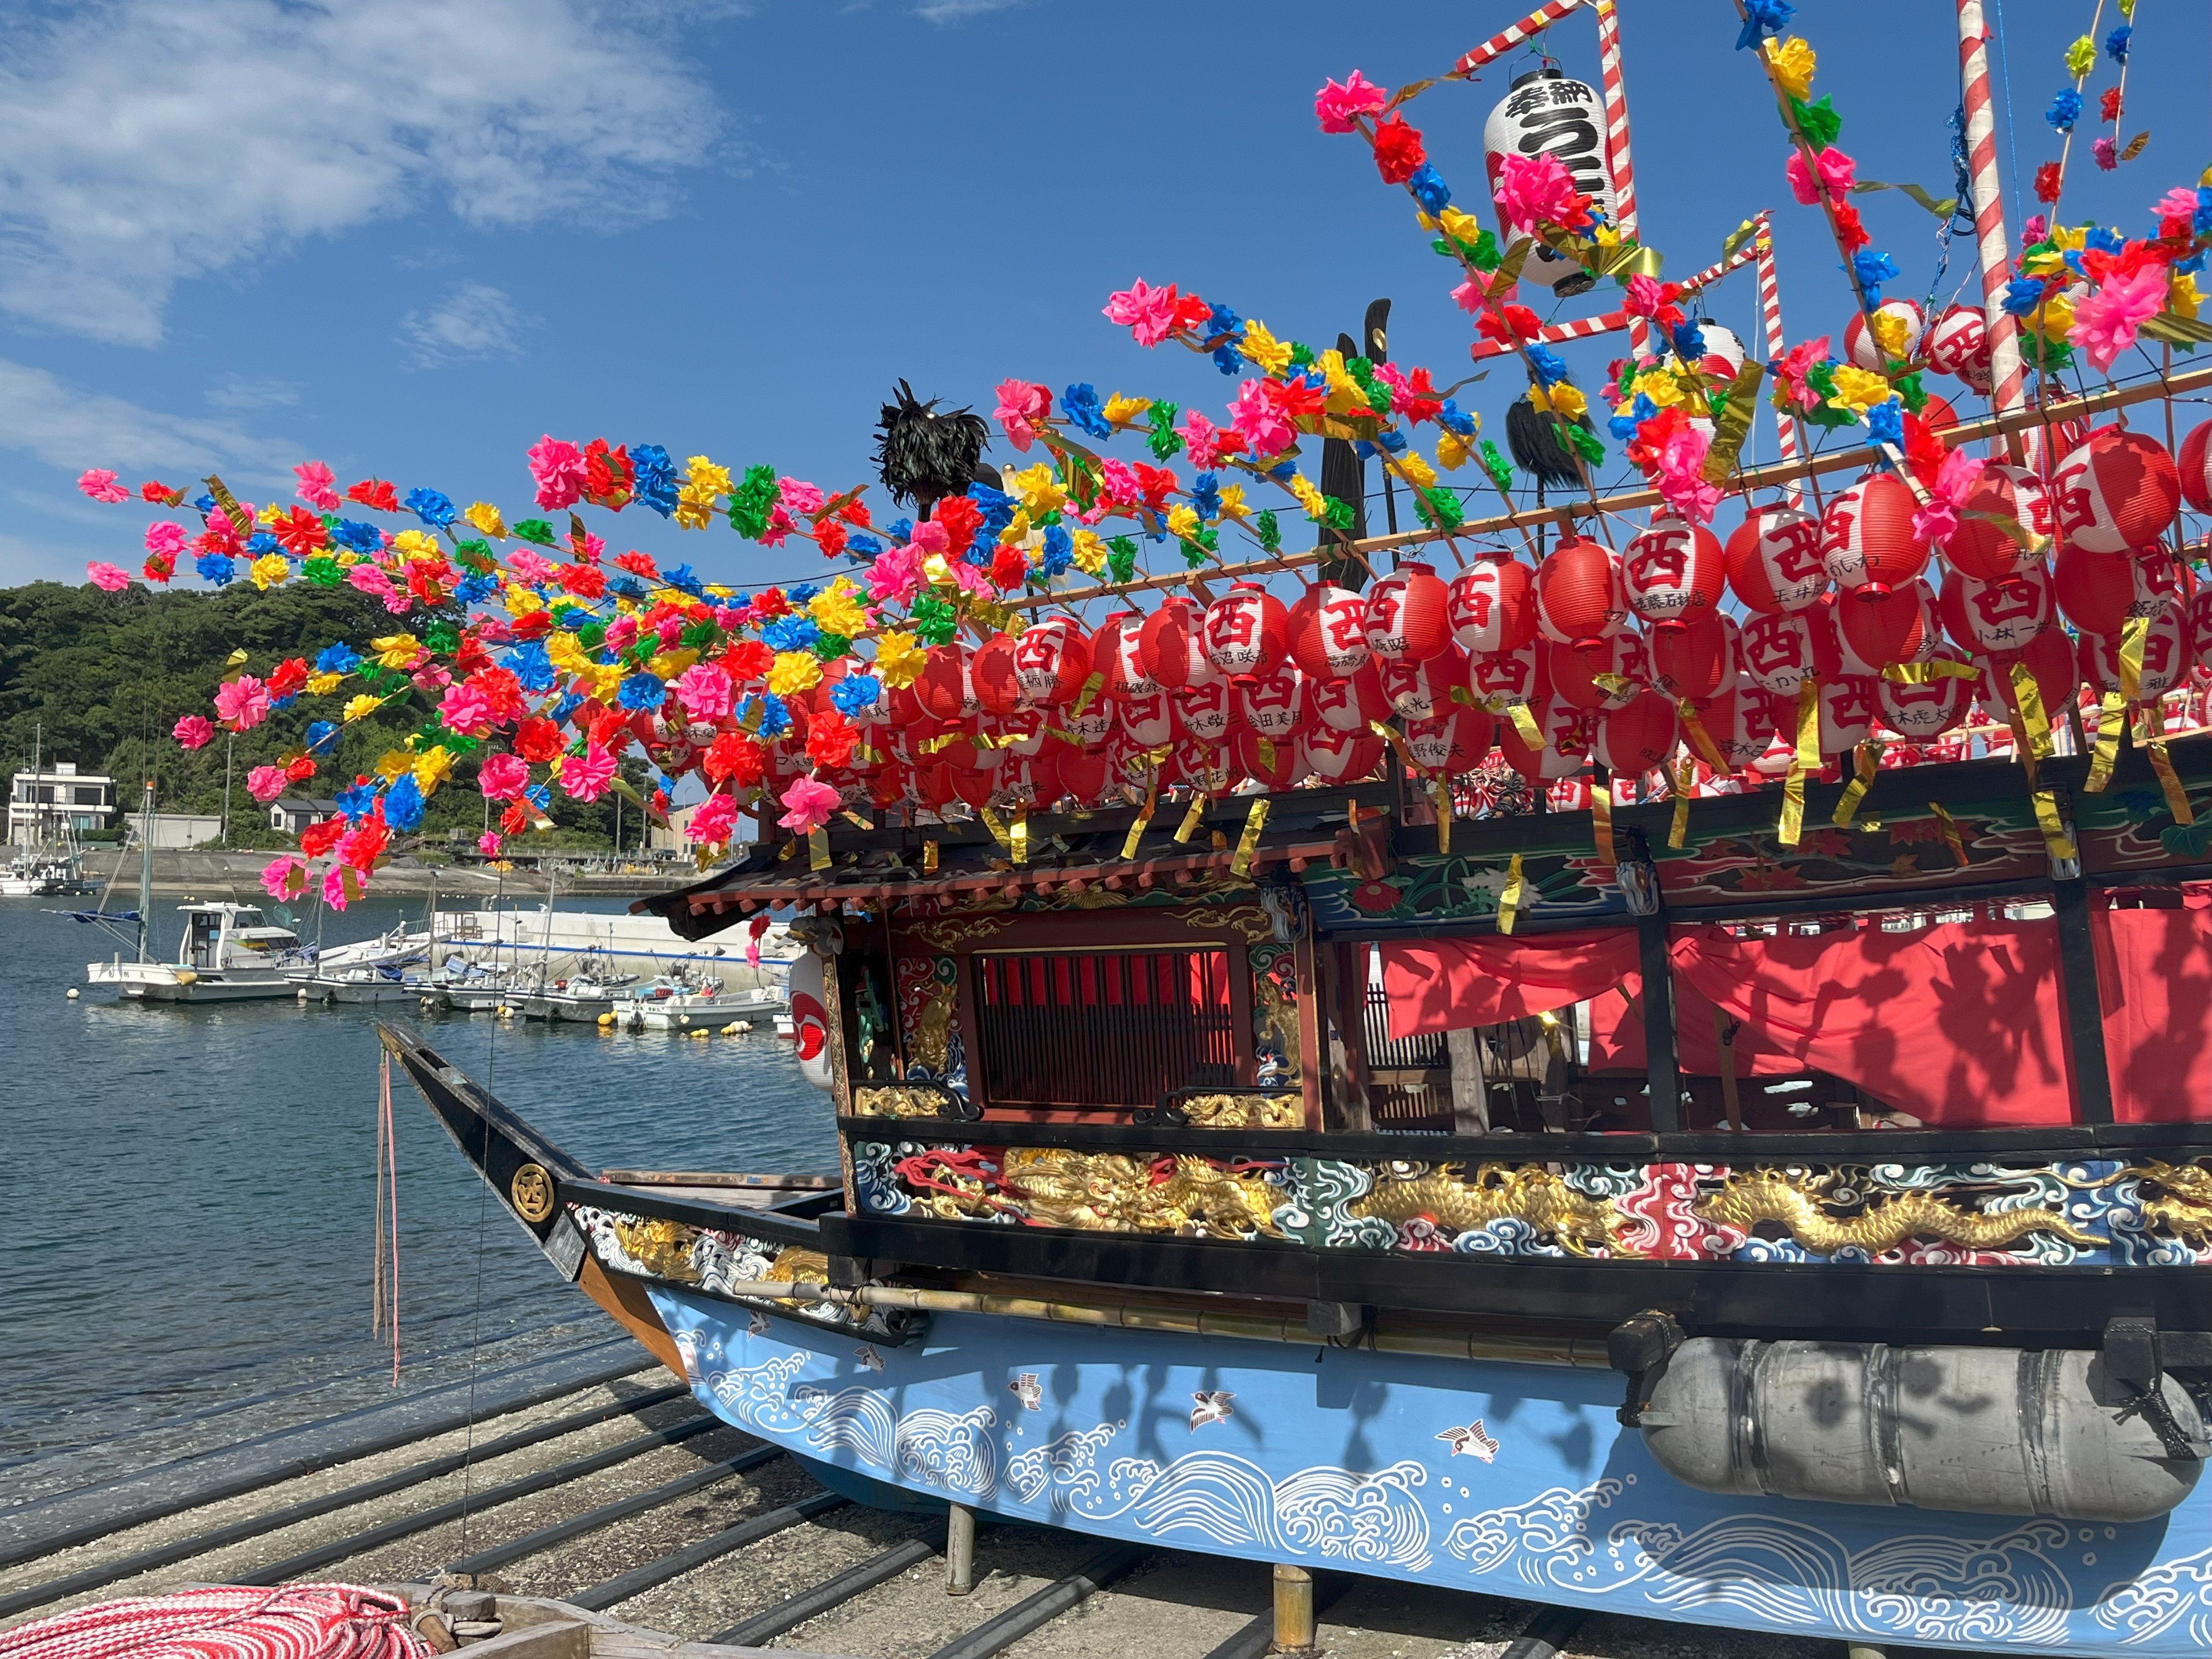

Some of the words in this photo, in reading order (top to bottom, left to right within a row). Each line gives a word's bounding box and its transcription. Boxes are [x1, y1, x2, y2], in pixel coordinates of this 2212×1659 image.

[1505, 81, 1593, 118] 奉納
[1766, 520, 1826, 583] 西
[1818, 492, 1860, 562] 西
[1627, 530, 1691, 594] 西
[1207, 596, 1258, 650] 西
[1323, 599, 1370, 651] 西
[1364, 581, 1406, 635] 西
[1449, 573, 1495, 631] 西
[1016, 629, 1064, 672] 西
[1745, 613, 1802, 676] 西
[1248, 710, 1302, 727] 金田美月
